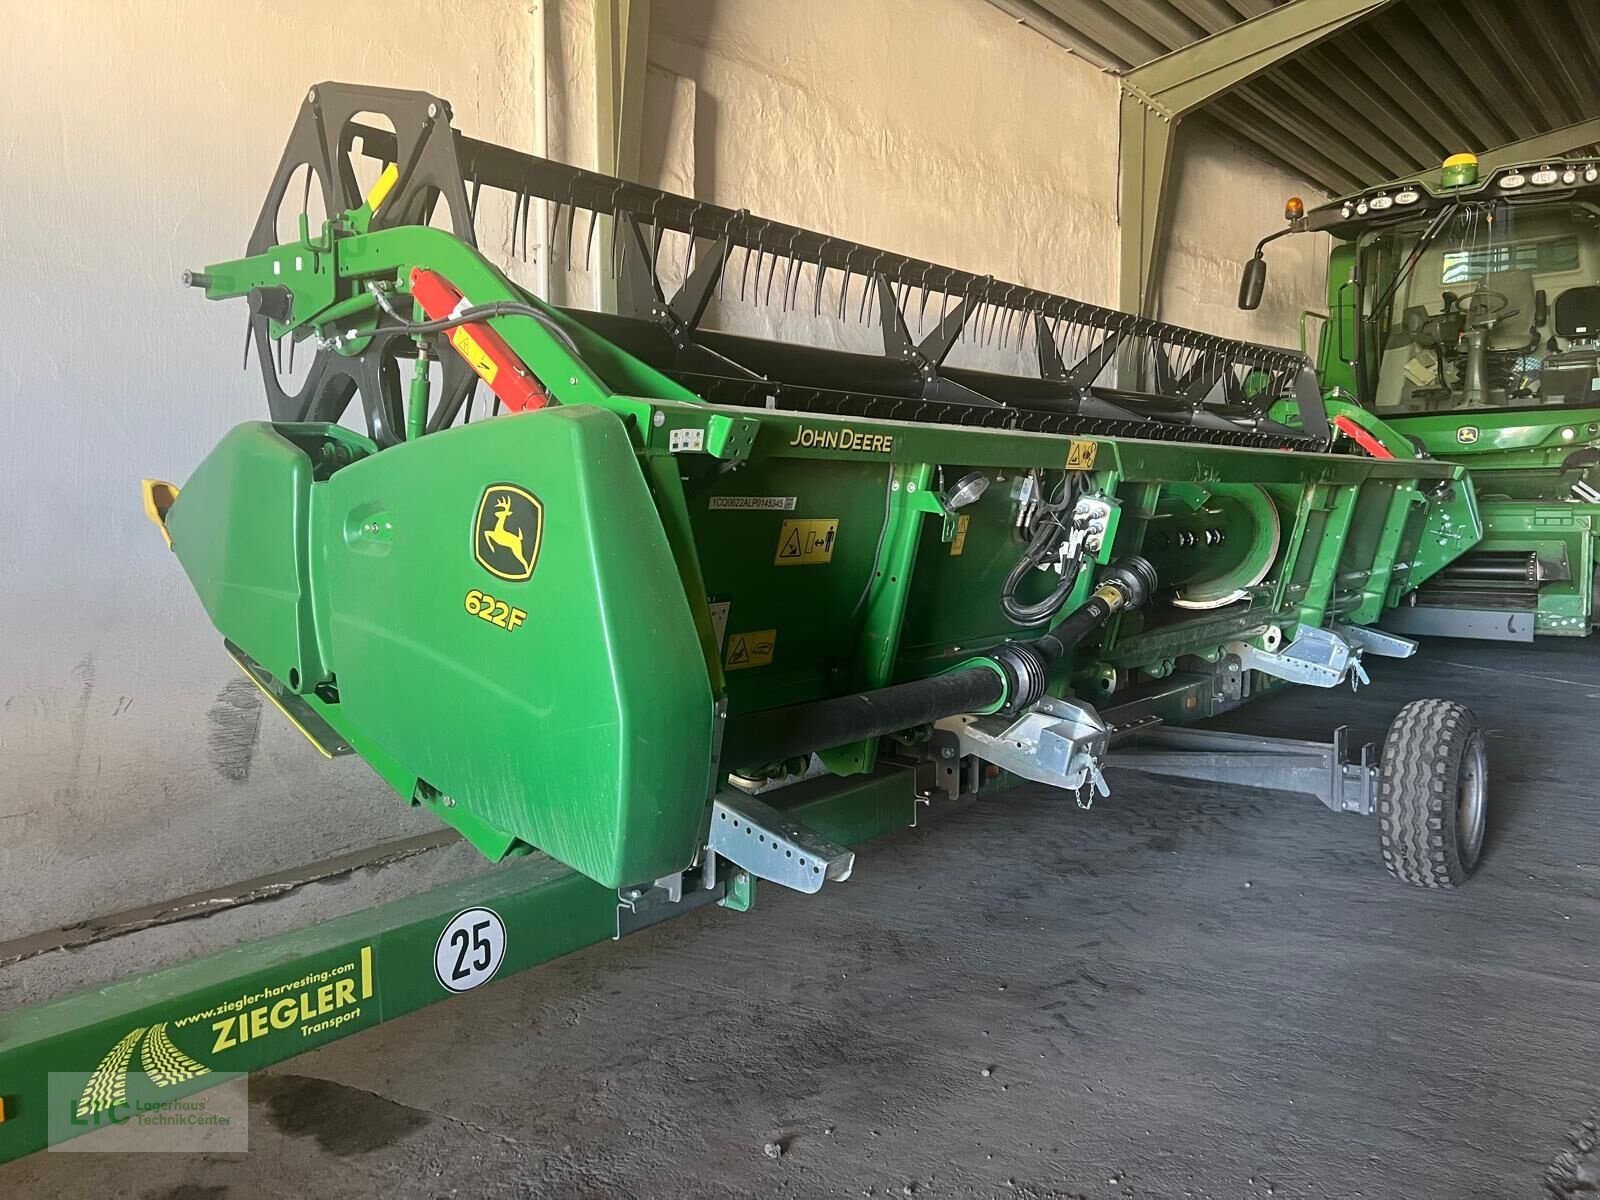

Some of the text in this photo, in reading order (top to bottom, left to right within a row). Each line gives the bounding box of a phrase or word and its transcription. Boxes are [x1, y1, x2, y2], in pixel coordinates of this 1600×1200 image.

[789, 424, 893, 453] JOHN DEERE
[464, 589, 528, 632] 622F
[450, 920, 491, 981] 25
[174, 962, 355, 1029] www.ziegler-harvesting.com
[211, 978, 358, 1054] ZIEGLER
[300, 1007, 361, 1037] Transport
